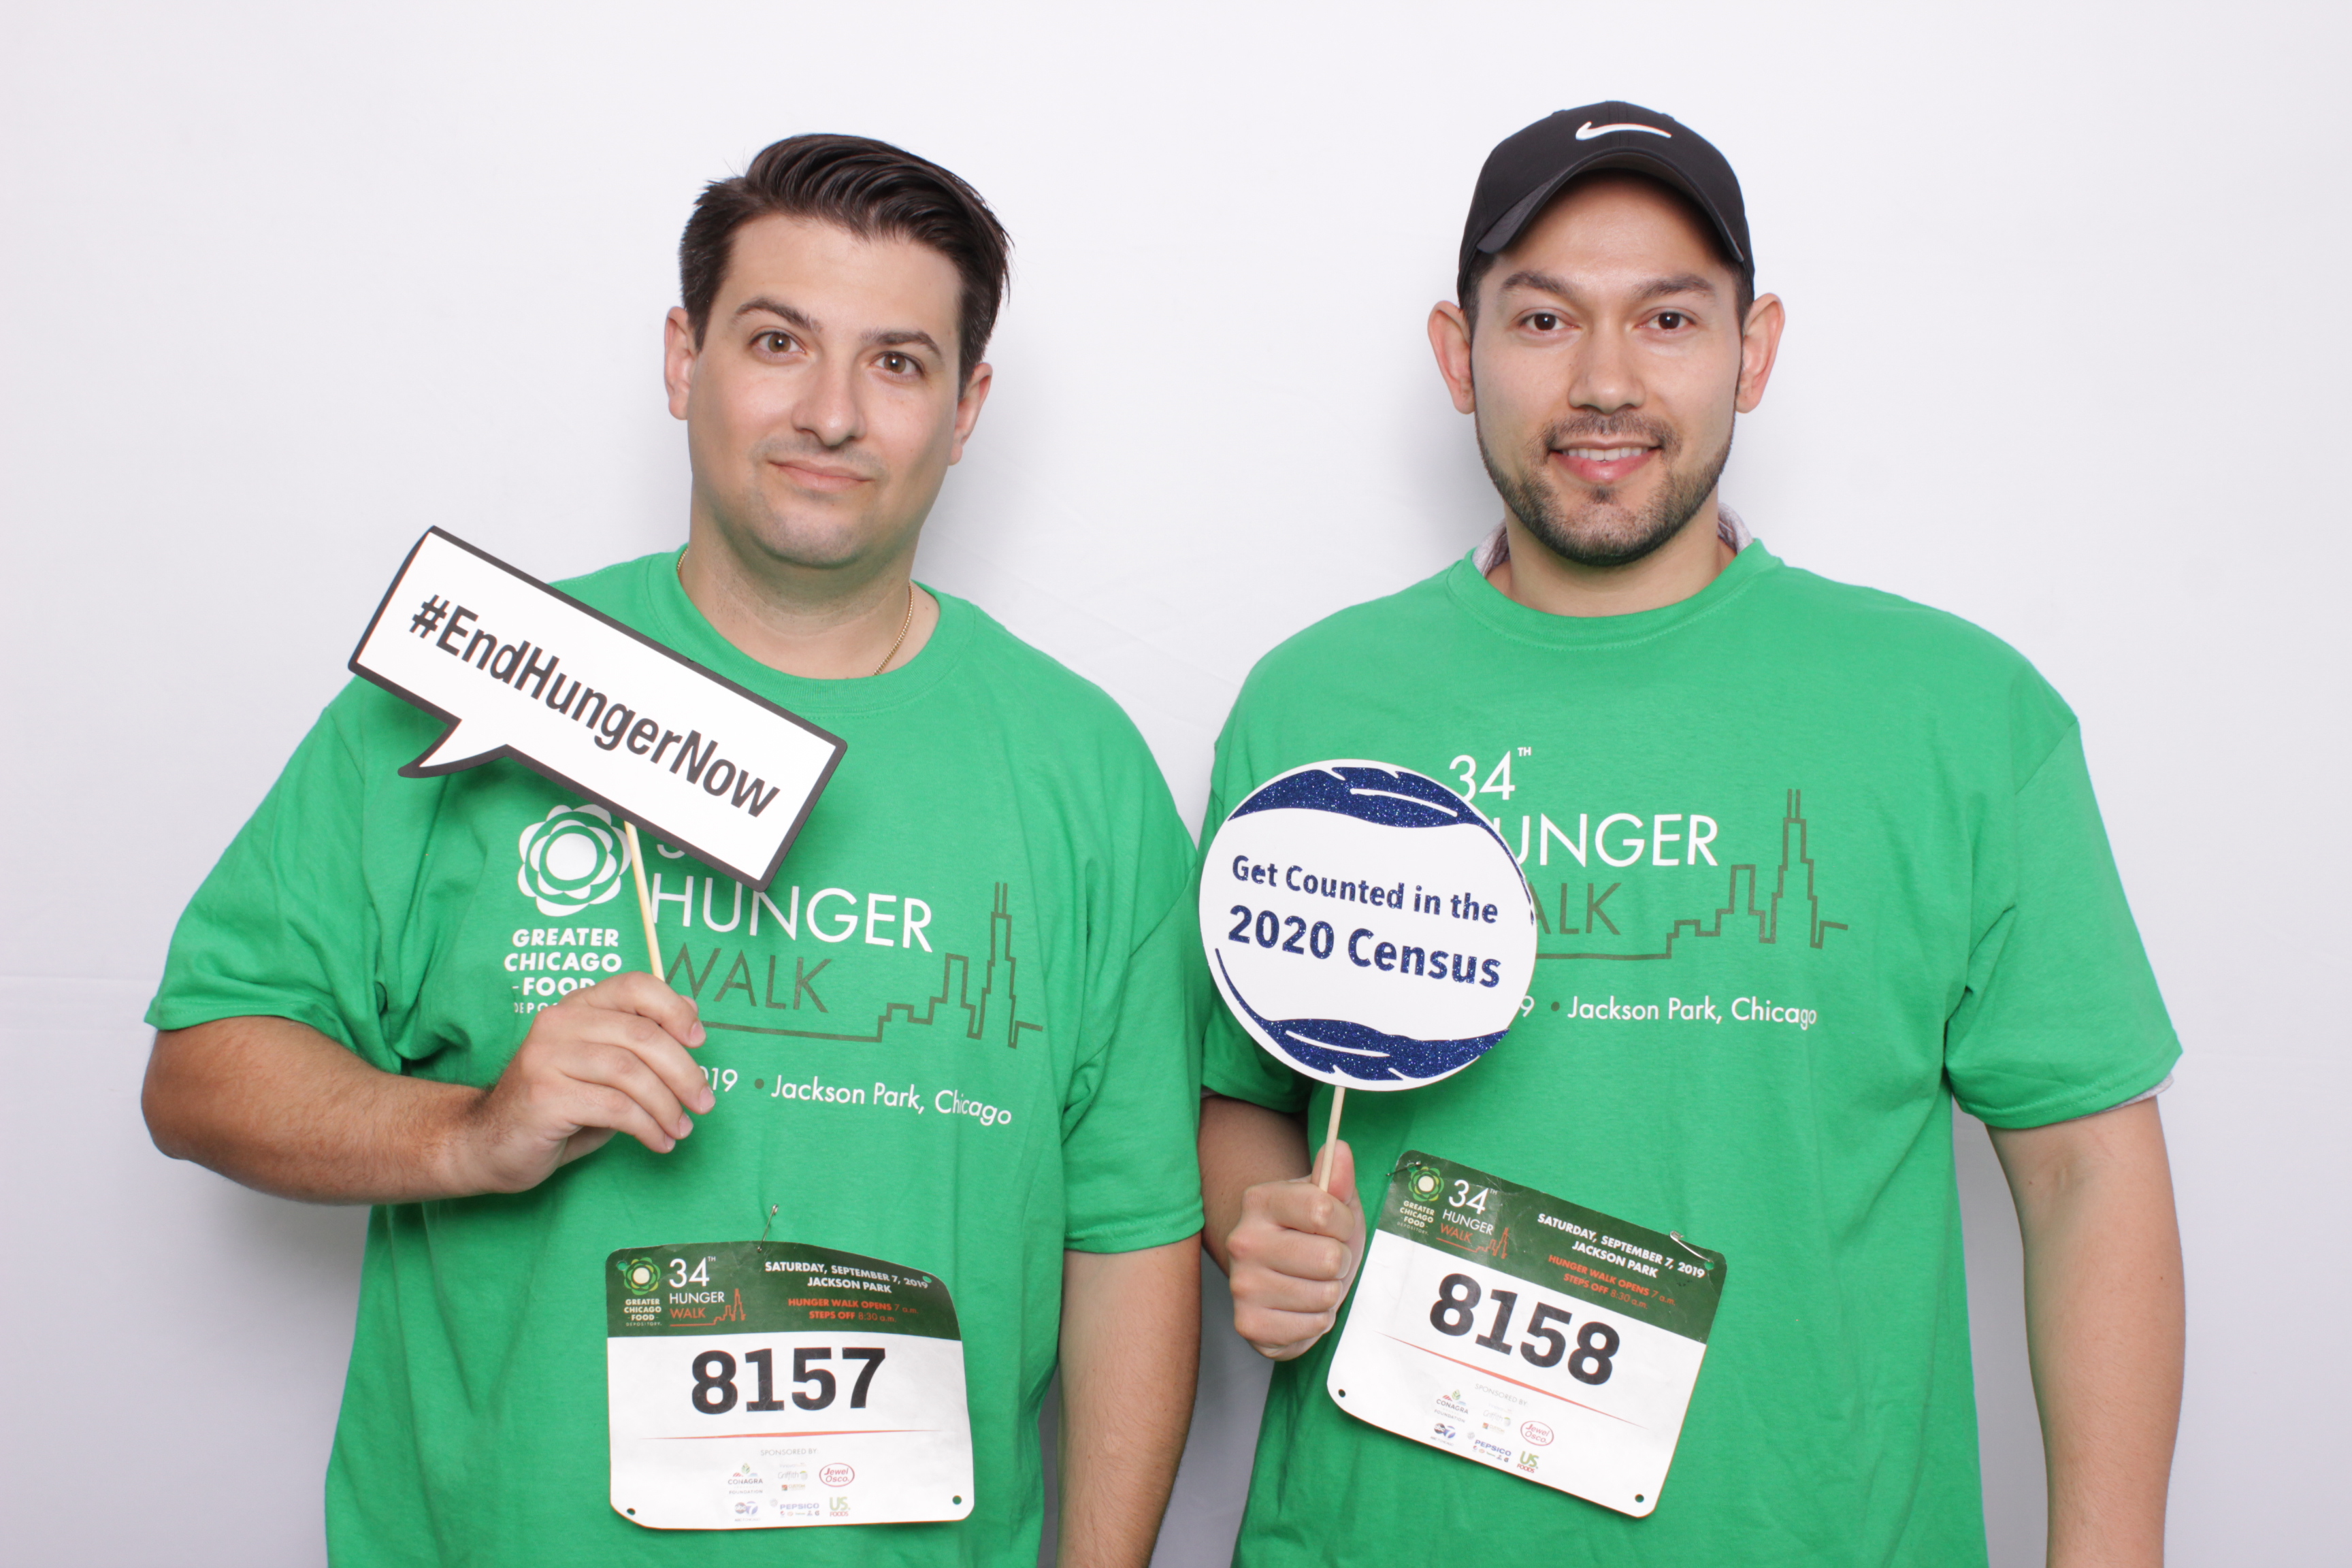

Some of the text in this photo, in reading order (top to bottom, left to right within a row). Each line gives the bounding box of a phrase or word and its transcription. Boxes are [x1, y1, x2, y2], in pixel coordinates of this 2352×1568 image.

[409, 594, 781, 817] #EndHungerNow
[1493, 813, 1718, 868] UNGER
[1232, 855, 1499, 924] Get Counted in the
[651, 873, 932, 953] HUNGER
[1528, 881, 1622, 935] ALK
[512, 928, 619, 948] GREATER
[1228, 904, 1502, 988] 2020 Census
[504, 951, 622, 973] CHICAGO
[1567, 995, 1659, 1021] Jackson
[1667, 995, 1722, 1025] Park,
[1731, 996, 1817, 1030] Chicago
[771, 1075, 864, 1105] Jackson
[873, 1082, 924, 1115] Park,
[934, 1089, 1012, 1126] Chicago
[1400, 1207, 1433, 1223] CHICAGO
[1403, 1200, 1435, 1216] GREATER
[1404, 1216, 1425, 1228] FOOD
[1442, 1209, 1494, 1236] HUNGER
[1440, 1223, 1473, 1243] WALK
[1537, 1213, 1705, 1279] SATURDAY, SEPTEMBER 7, 2019
[1572, 1241, 1659, 1279] JACKSON PARK
[765, 1261, 928, 1289] SATURDAY, SEPTEMBER 7, 2019
[807, 1277, 892, 1293] JACKSON PARK
[1548, 1255, 1588, 1275] HUNGER
[1590, 1269, 1617, 1285] WALK
[1618, 1279, 1650, 1296] OPENS
[1652, 1290, 1659, 1298] 7
[669, 1292, 725, 1304] HUNGER
[1563, 1273, 1590, 1288] STEPS
[1590, 1282, 1610, 1294] OFF
[1610, 1289, 1631, 1303] 8:30
[670, 1307, 706, 1318] WALK
[788, 1298, 830, 1307] HUNGER
[831, 1299, 859, 1308] WALK
[861, 1301, 892, 1311] OPENS
[808, 1311, 836, 1320] STEPS
[838, 1311, 855, 1320] OFF
[858, 1312, 878, 1321] 8:30
[1429, 1273, 1620, 1386] 8158
[691, 1347, 885, 1415] 8157
[1475, 1383, 1518, 1403] SPONSORED
[1434, 1409, 1466, 1423] FOUNDATION
[1436, 1399, 1469, 1415] CONAGRA
[1525, 1424, 1550, 1437] Jewel
[1475, 1439, 1512, 1456] PEPSICO
[823, 1467, 849, 1475] Jewel
[1516, 1463, 1535, 1473] FOODS
